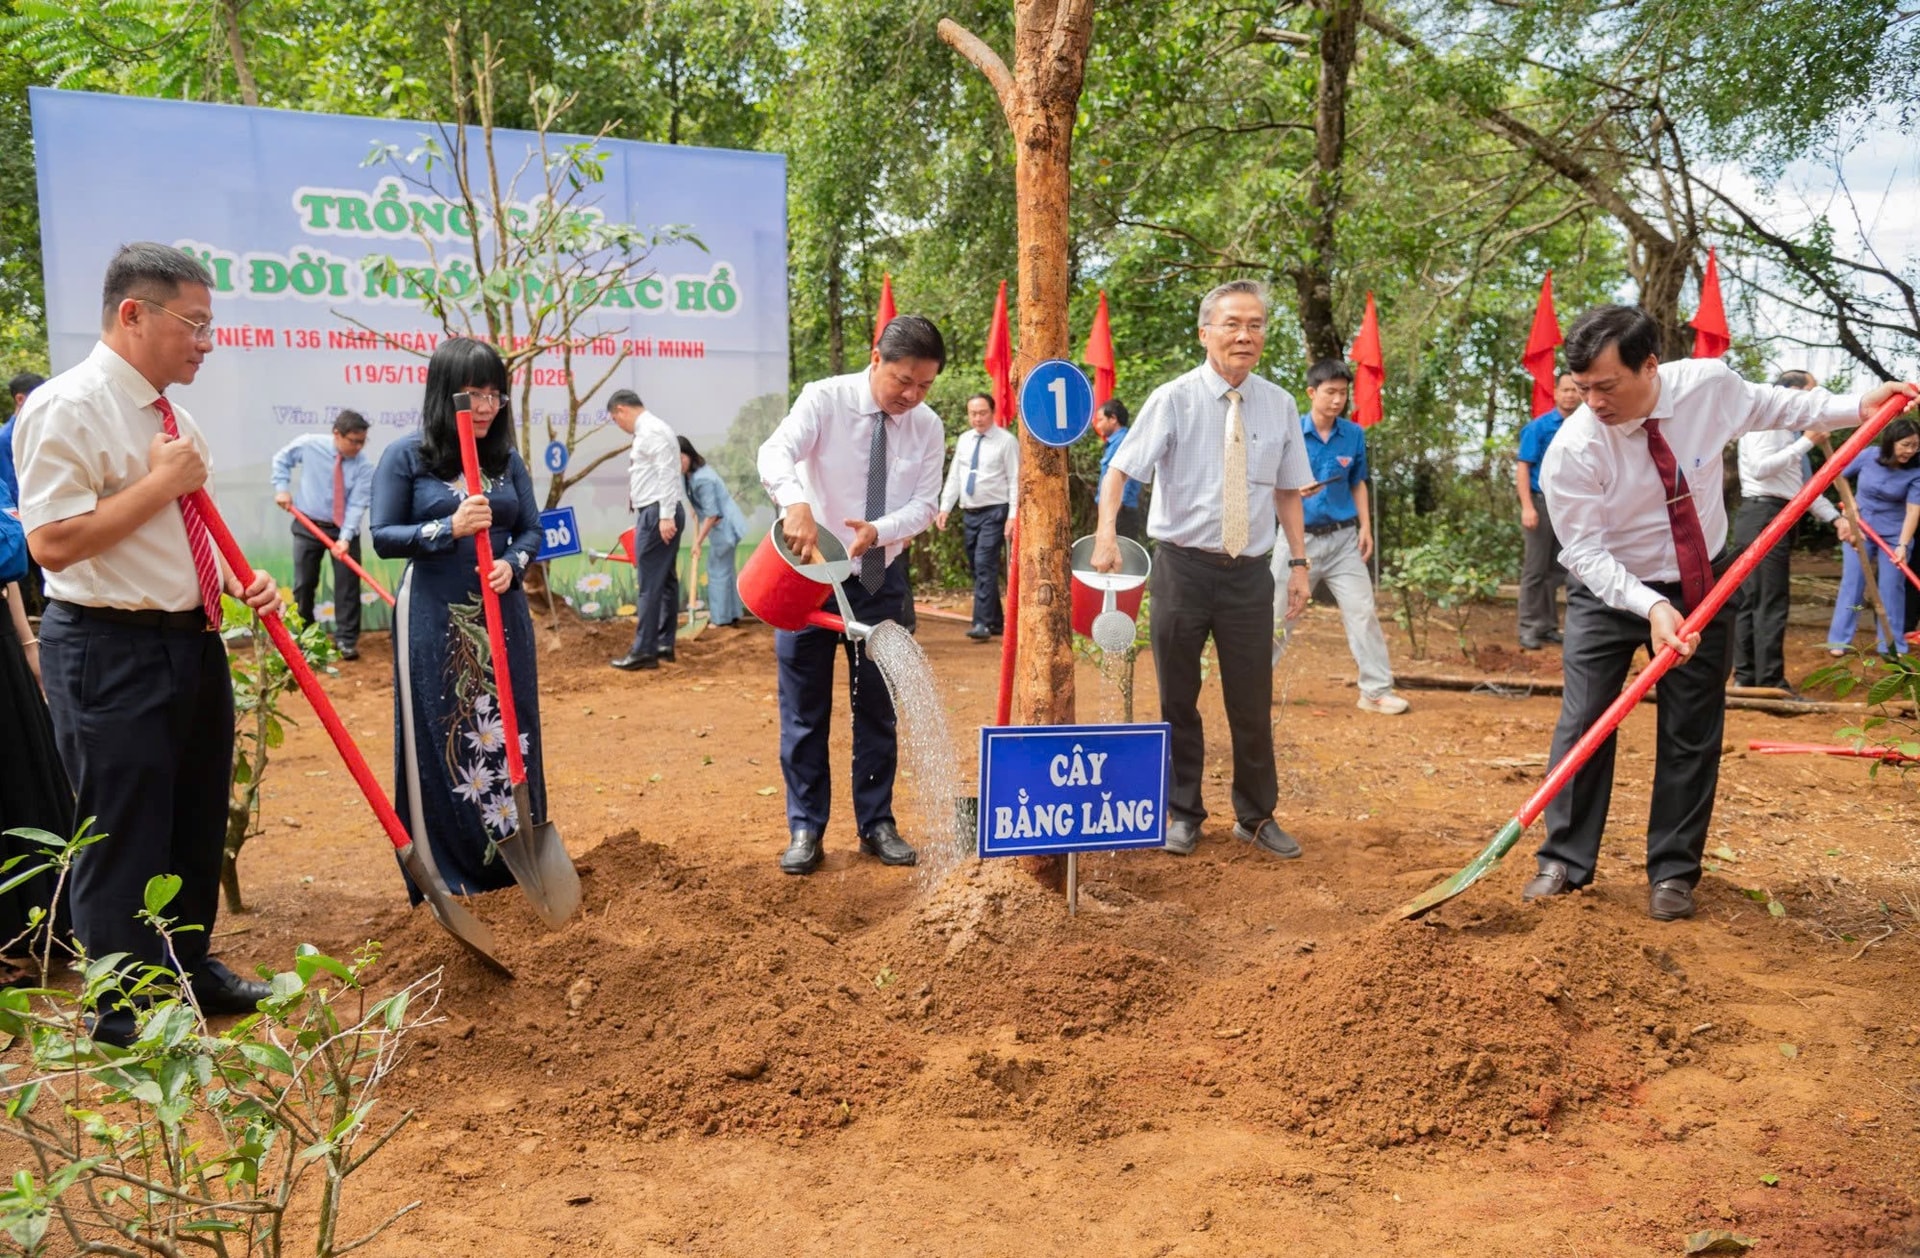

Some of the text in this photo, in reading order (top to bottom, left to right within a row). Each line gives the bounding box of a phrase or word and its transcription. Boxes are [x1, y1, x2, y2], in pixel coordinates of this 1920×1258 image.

[249, 252, 348, 296] ĐỜI
[216, 323, 275, 352] NIỆM
[283, 329, 321, 349] 136
[658, 340, 706, 359] MINH
[1047, 377, 1068, 429] 1
[551, 447, 562, 468] 3
[1050, 743, 1108, 787] CÂY
[994, 788, 1155, 840] BẰNG LĂNG
